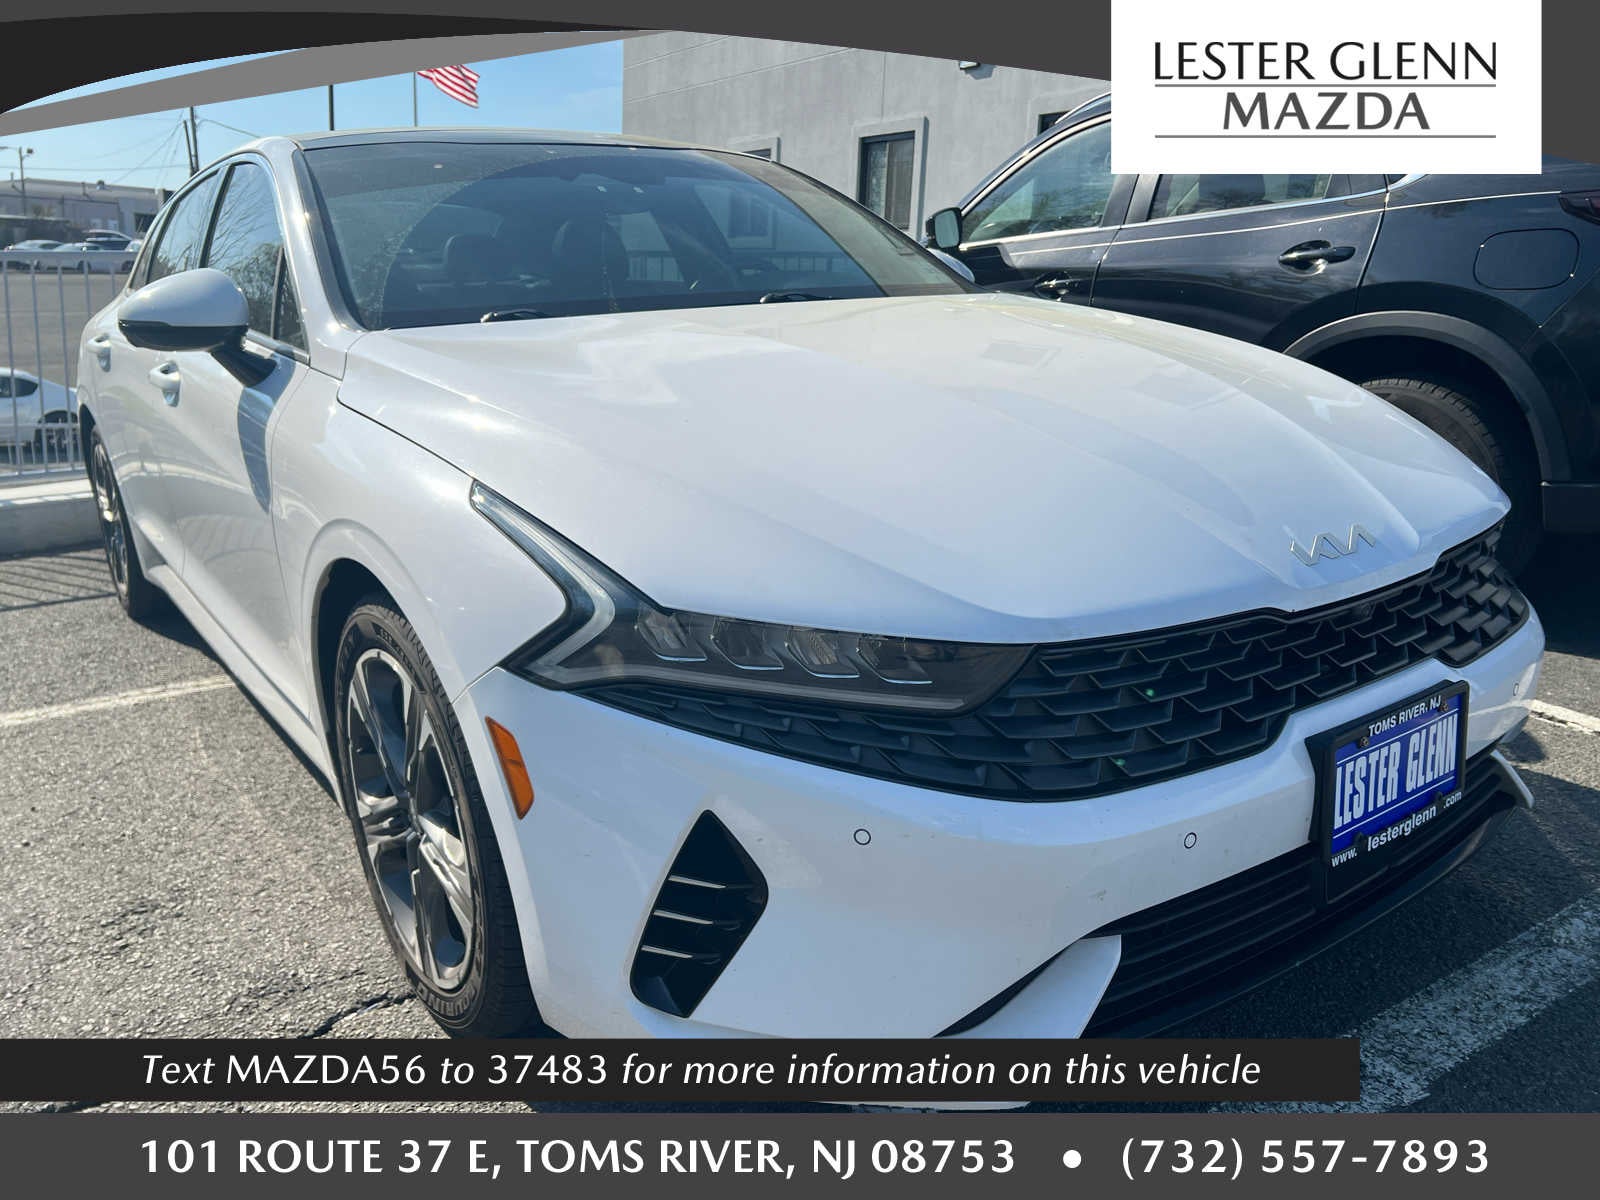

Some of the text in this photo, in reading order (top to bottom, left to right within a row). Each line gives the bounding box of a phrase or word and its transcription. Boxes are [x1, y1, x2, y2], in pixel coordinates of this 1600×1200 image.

[1368, 716, 1398, 737] TOMS
[1429, 695, 1442, 711] NJ
[1333, 713, 1459, 830] LESTER GLENN
[1331, 848, 1358, 868] www.
[1367, 804, 1437, 852] lesterglenn
